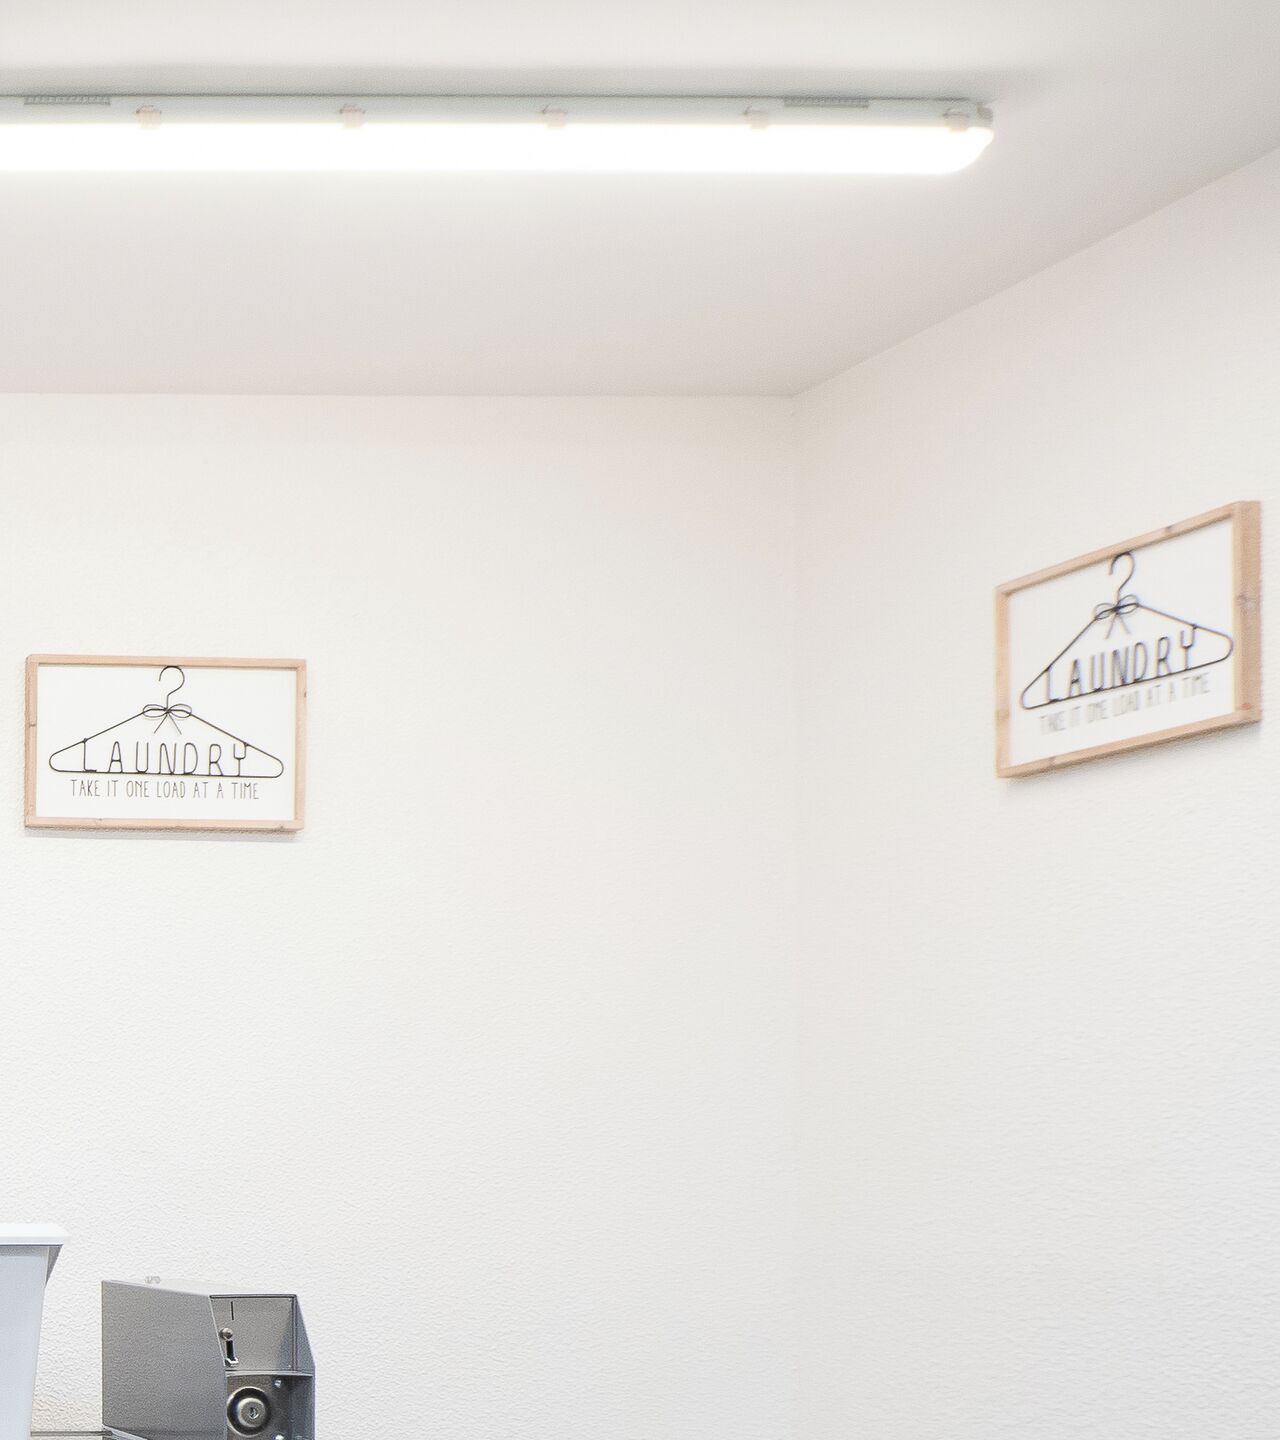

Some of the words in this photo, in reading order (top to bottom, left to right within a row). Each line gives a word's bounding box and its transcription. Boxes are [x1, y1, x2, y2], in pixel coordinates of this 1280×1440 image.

[1046, 624, 1196, 703] LAUNDRY
[82, 739, 247, 777] LAUNDRY
[71, 778, 100, 797] TAKE
[107, 779, 118, 798] IT
[126, 780, 149, 798] ONE
[157, 780, 185, 798] LOAD
[193, 781, 209, 799] AT
[218, 782, 224, 799] A
[231, 782, 260, 800] TIME
